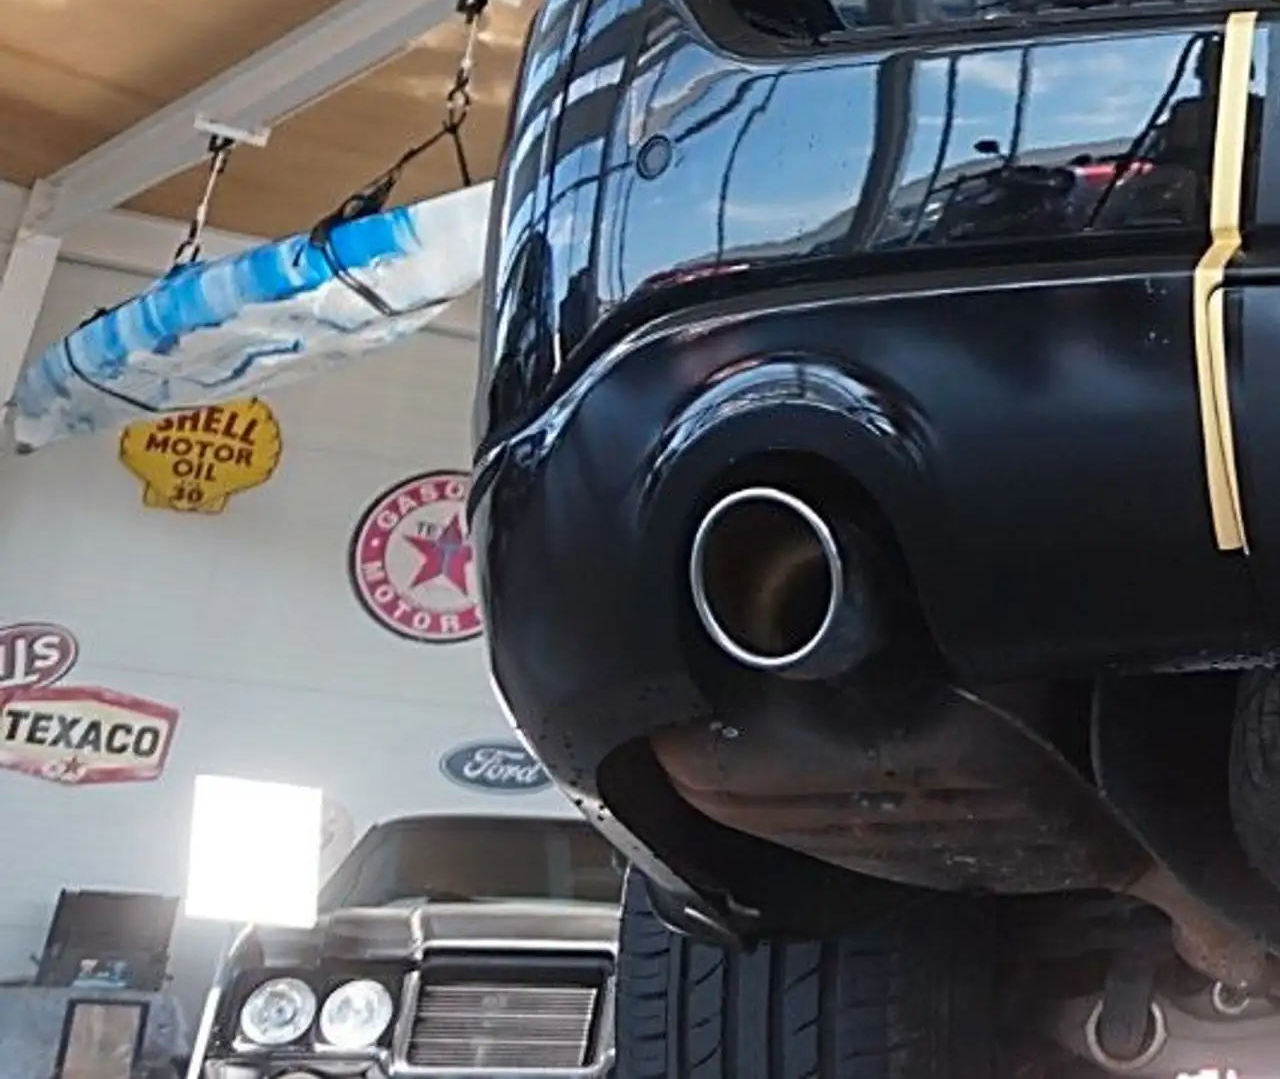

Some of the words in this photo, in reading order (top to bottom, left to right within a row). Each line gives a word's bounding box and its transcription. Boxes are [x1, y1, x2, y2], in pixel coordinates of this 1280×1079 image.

[145, 433, 253, 467] MOTOR
[173, 459, 216, 481] OIL
[377, 481, 466, 529] GASO
[363, 560, 460, 633] MOTOR
[0, 635, 61, 687] ST
[5, 709, 160, 758] TEXACO
[463, 748, 541, 783] Ford
